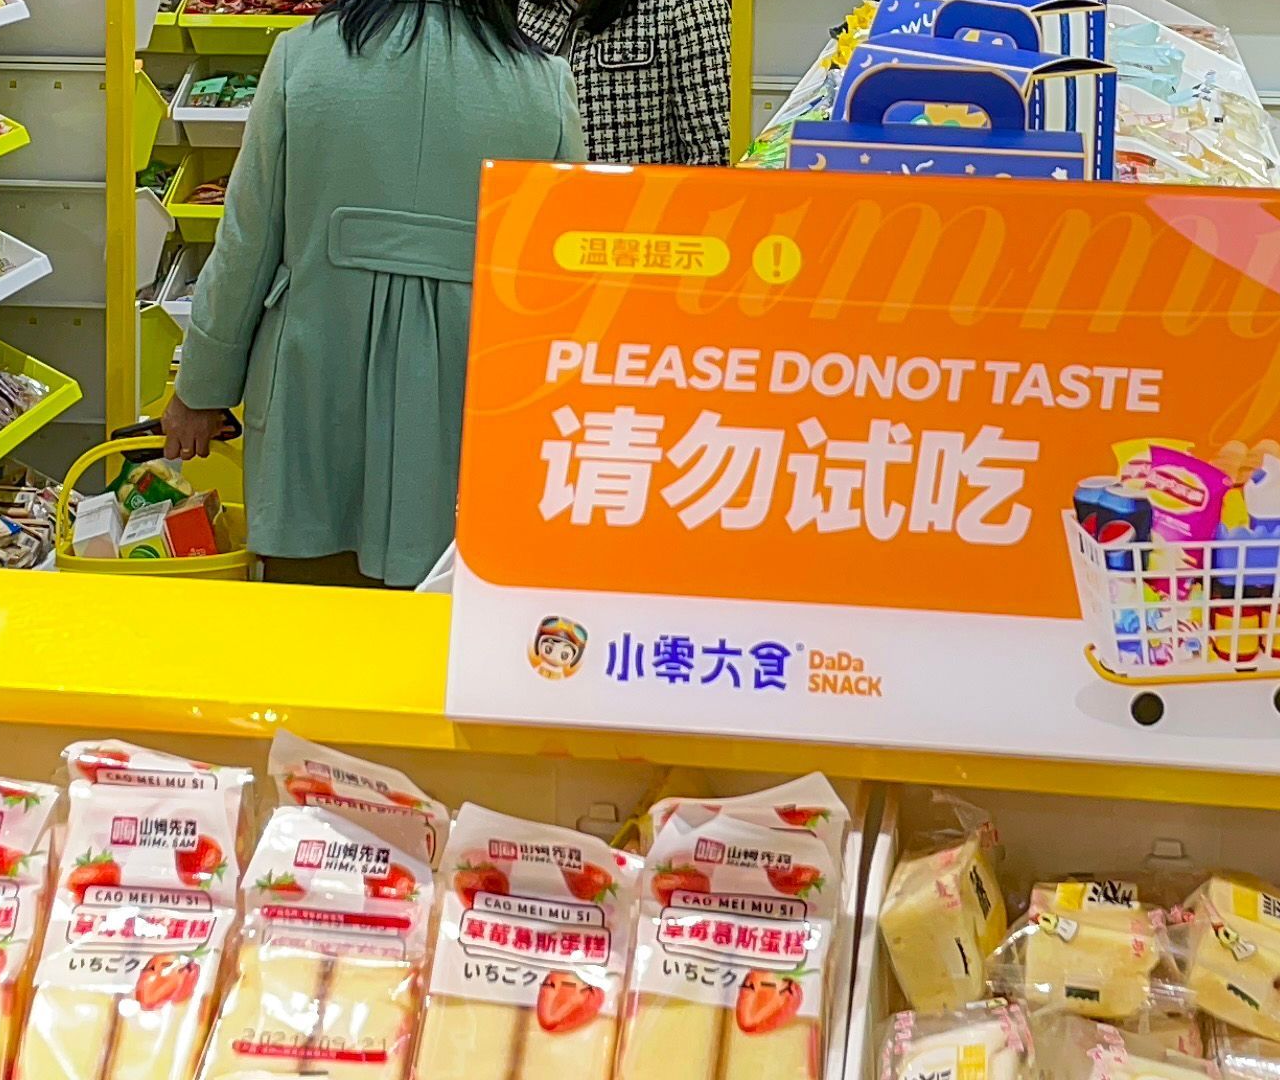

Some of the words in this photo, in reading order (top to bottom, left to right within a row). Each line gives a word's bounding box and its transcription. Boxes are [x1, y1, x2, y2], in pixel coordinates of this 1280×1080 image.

[578, 235, 706, 271] 温馨提示
[545, 340, 758, 396] PLEASE
[767, 349, 977, 407] DONOT
[985, 358, 1162, 413] TASTE
[538, 404, 1040, 546] 请勿试吃
[809, 649, 865, 674] DaDa
[808, 673, 883, 698] SNACK
[95, 892, 124, 903] CAO
[129, 893, 155, 904] MEI
[159, 893, 181, 905] MU
[484, 897, 512, 910] CAO
[517, 902, 543, 915] MEI
[549, 906, 571, 920] MU
[683, 894, 712, 906] CAO
[718, 897, 745, 911] MEI
[752, 901, 774, 914] MU
[464, 917, 606, 959] 草莓慕斯蛋糕
[663, 916, 806, 956] 草莓慕斯蛋糕
